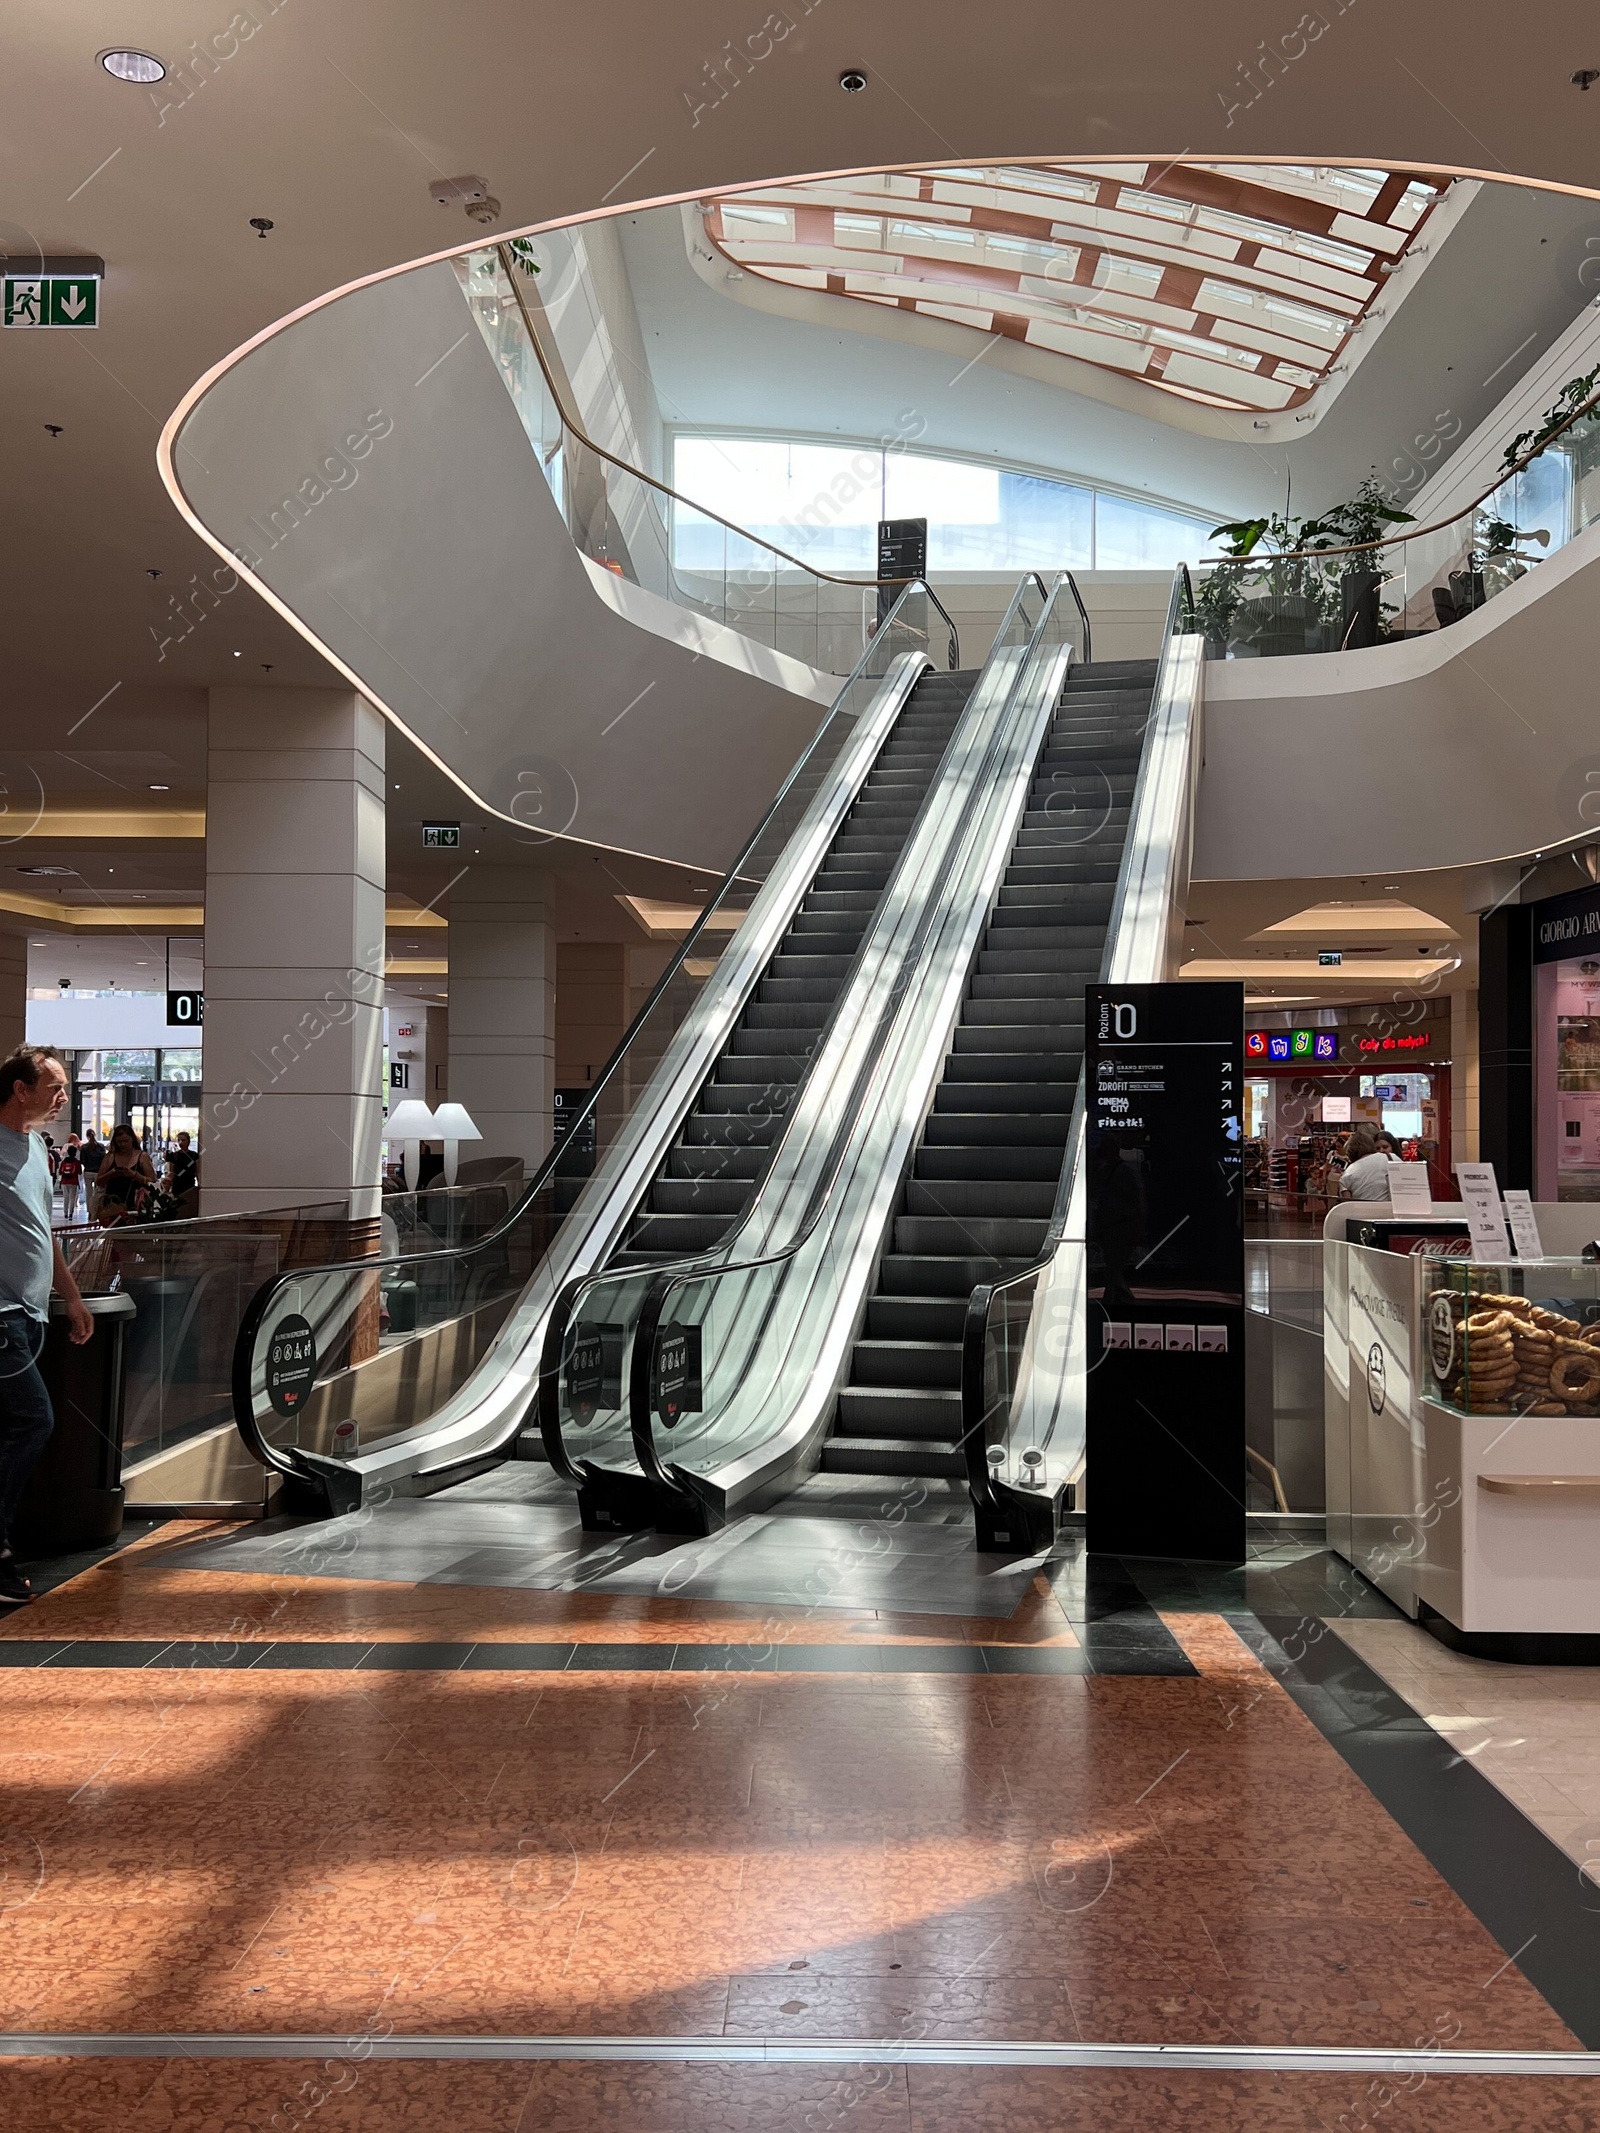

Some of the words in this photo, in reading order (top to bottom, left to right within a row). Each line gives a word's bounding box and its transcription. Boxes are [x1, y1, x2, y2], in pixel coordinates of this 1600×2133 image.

[1540, 915, 1580, 944] GIORGIO
[1098, 1003, 1109, 1039] Poziom
[1115, 1003, 1137, 1038] 0
[1383, 1037, 1396, 1049] dla
[1098, 1082, 1128, 1091] ZDROFIT
[1098, 1097, 1129, 1106] CINEMA
